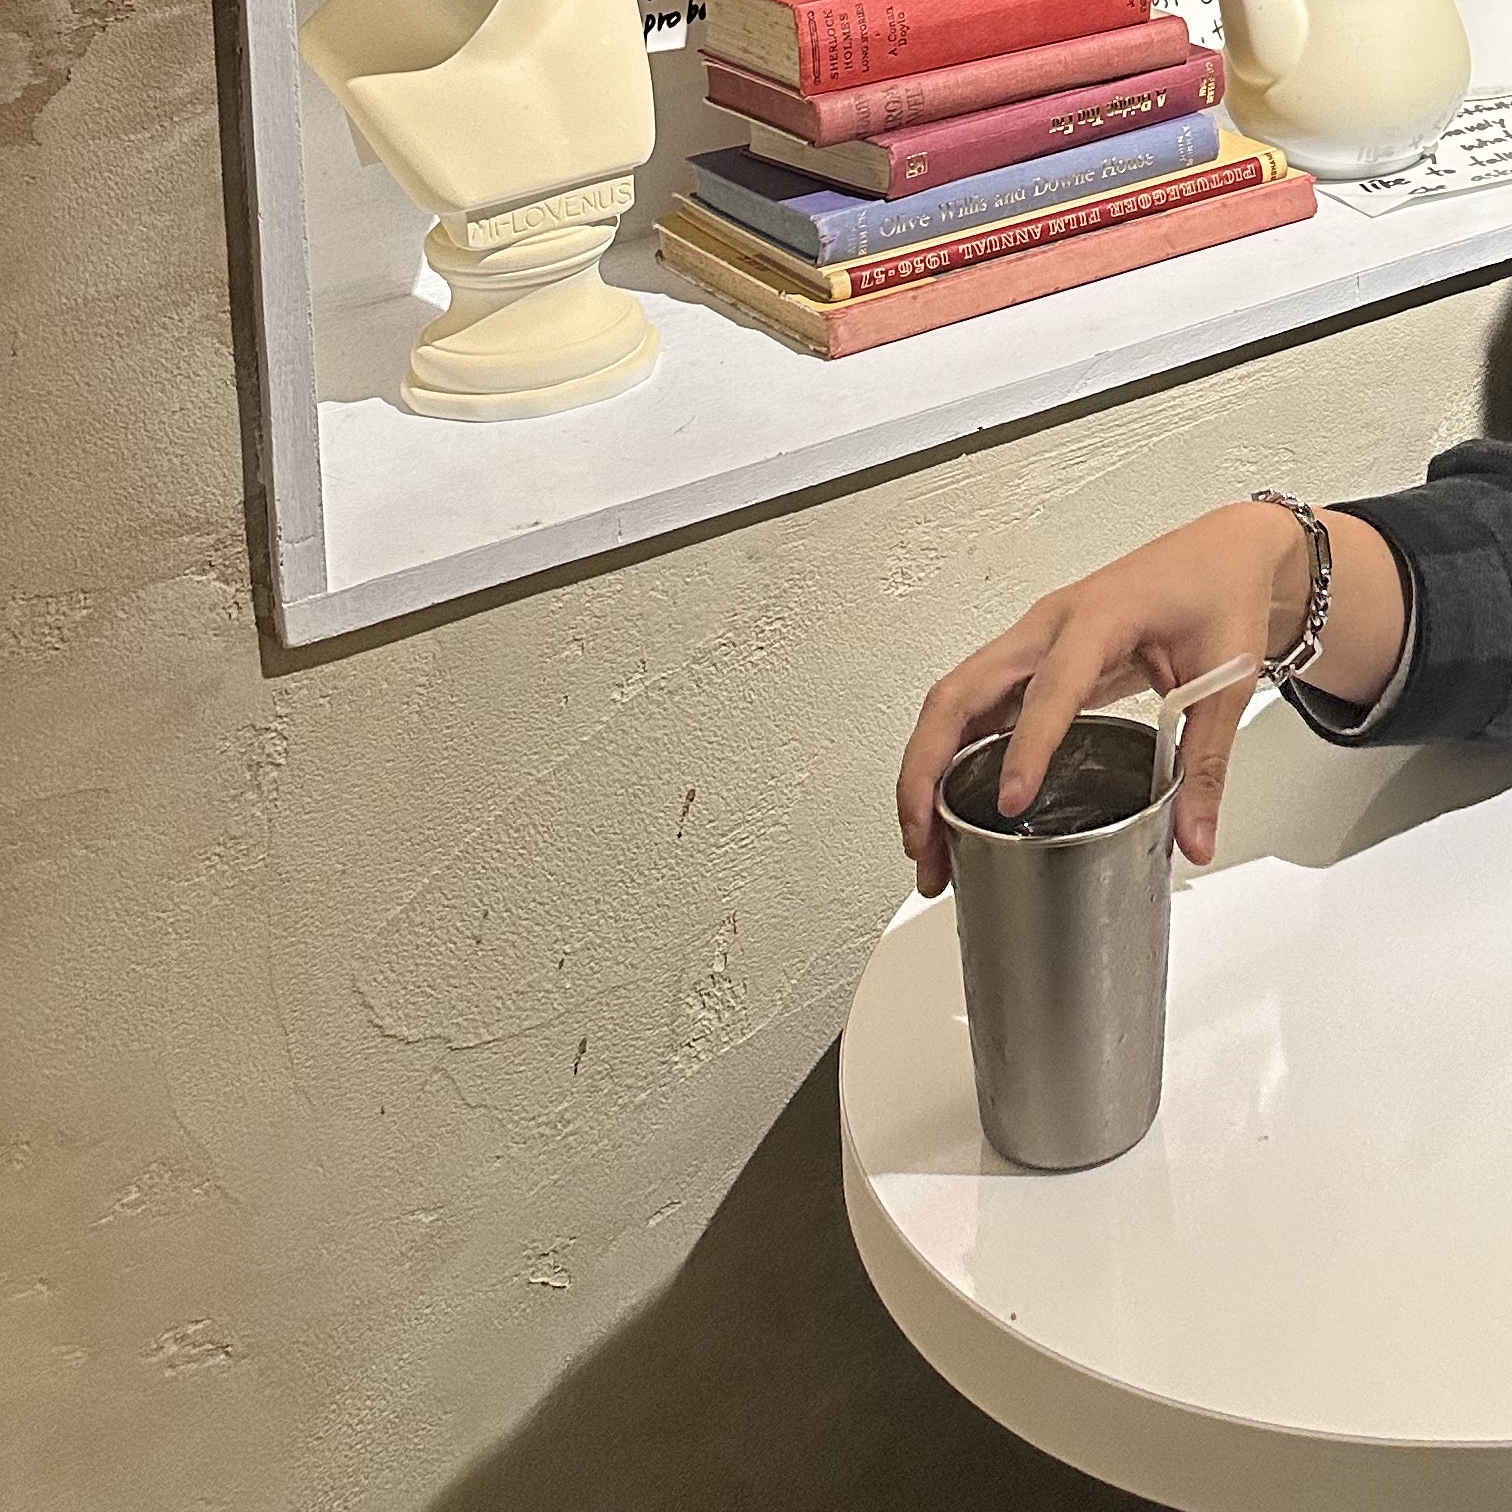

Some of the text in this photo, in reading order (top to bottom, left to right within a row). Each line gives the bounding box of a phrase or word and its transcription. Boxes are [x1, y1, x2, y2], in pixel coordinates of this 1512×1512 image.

[823, 9, 838, 79] SHERLOCK
[839, 13, 853, 69] HOLMES
[879, 205, 931, 238] Olive
[994, 182, 1026, 208] and
[1032, 167, 1095, 196] Downe
[1101, 152, 1155, 181] House
[1108, 164, 1257, 217] PICTUREGOER
[958, 224, 1042, 258] ANNUAL
[1048, 207, 1100, 234] FILM
